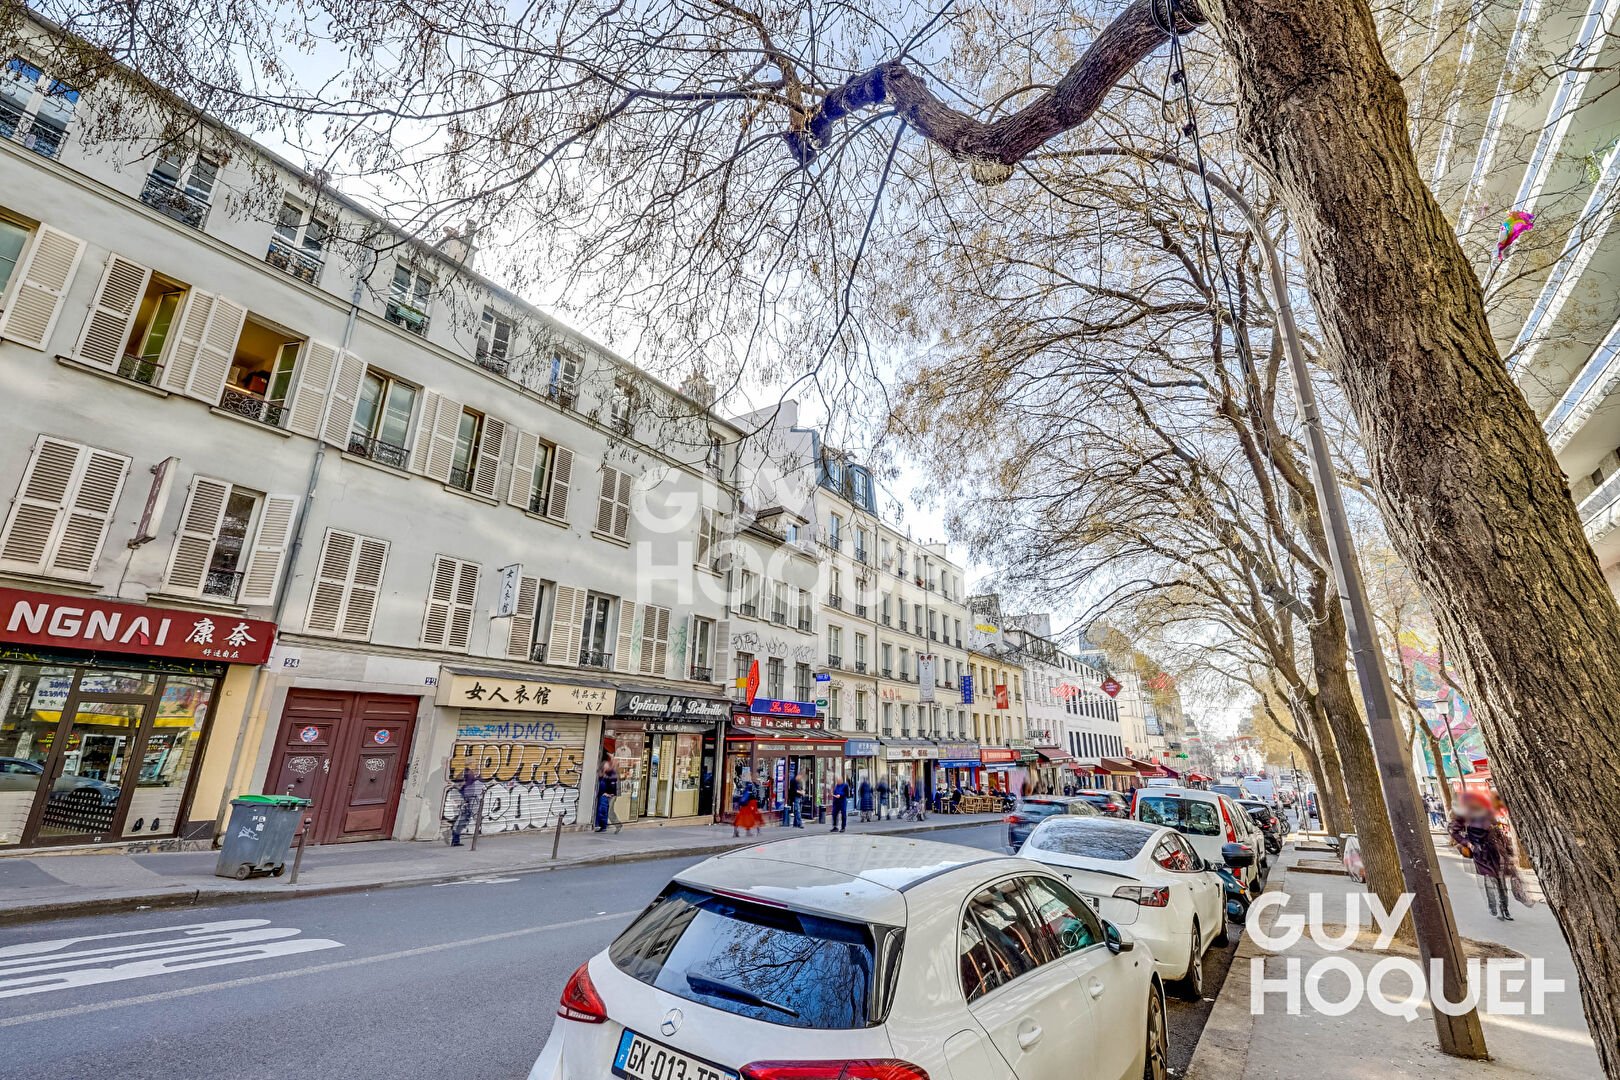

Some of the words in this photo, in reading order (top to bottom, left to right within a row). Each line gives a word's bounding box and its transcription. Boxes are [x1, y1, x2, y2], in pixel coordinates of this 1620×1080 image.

[6, 600, 171, 646] NGNAI
[185, 618, 256, 647] 康奈
[284, 658, 299, 667] 24
[425, 677, 437, 685] 22
[465, 681, 552, 706] 女人衣馆
[629, 695, 668, 714] Opticiens
[671, 698, 682, 713] de
[686, 700, 723, 716] Belleville
[766, 719, 774, 727] Le
[776, 720, 793, 728] Celtic
